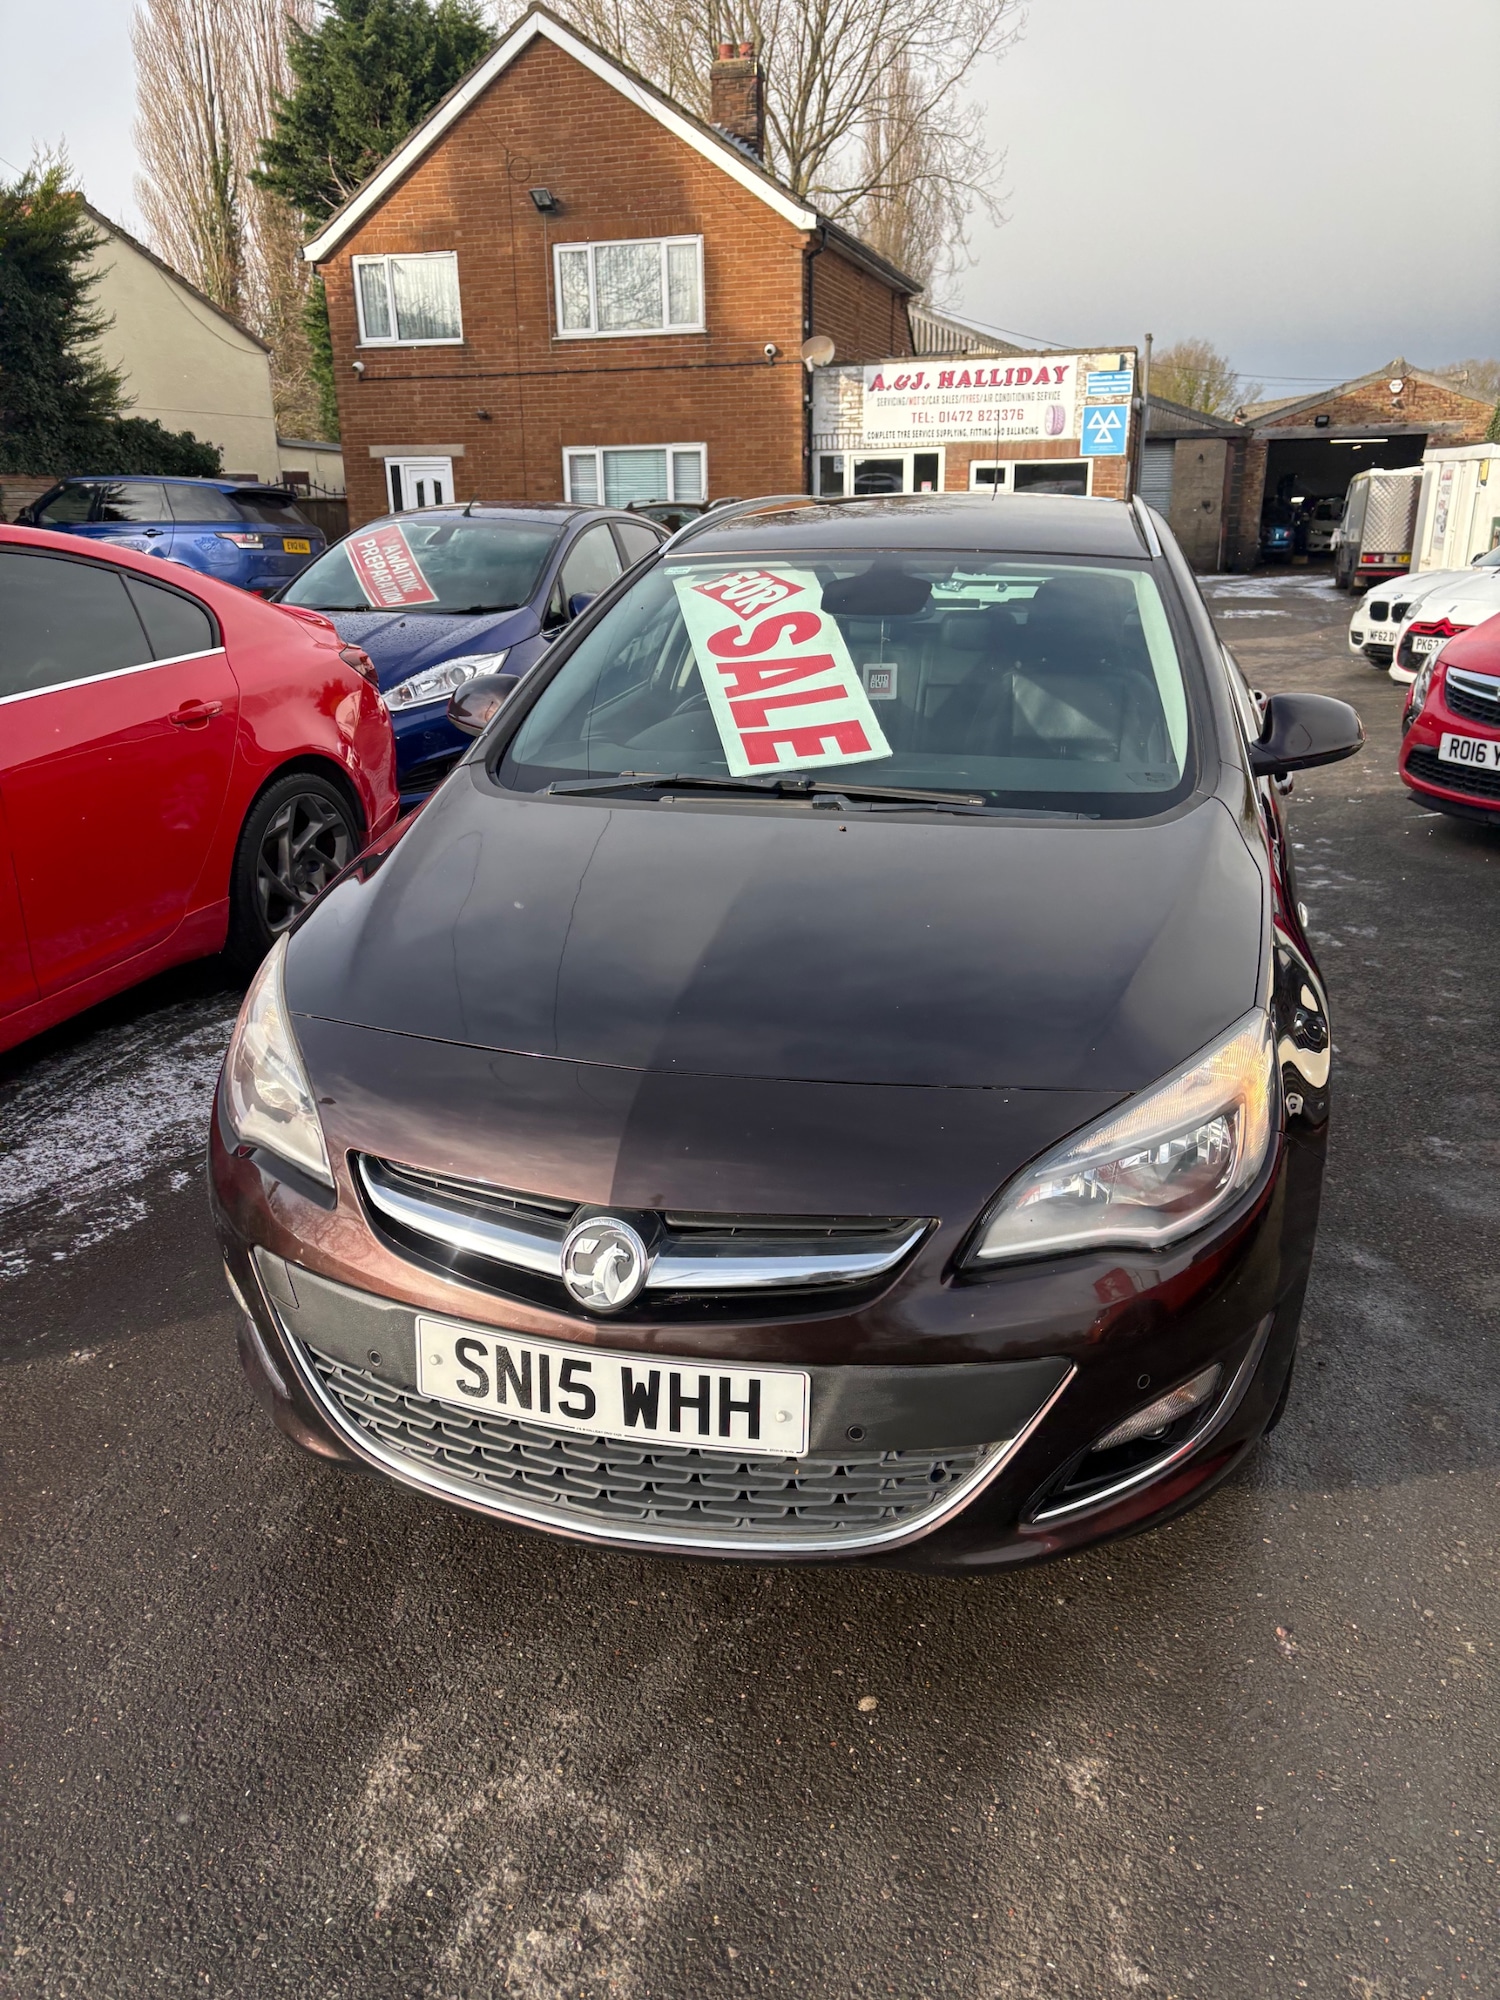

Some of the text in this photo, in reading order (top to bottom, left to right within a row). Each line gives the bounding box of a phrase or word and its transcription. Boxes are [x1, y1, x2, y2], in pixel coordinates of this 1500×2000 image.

[937, 365, 1070, 390] HALLIDAY
[994, 391, 1036, 402] CONDITIONING
[1036, 390, 1061, 401] SERVICE
[911, 408, 1025, 424] TEL: 01472 823376
[867, 429, 896, 440] COMPLETE
[897, 429, 911, 439] TYRE
[912, 428, 935, 439] SERVICE
[969, 427, 992, 437] FITTING
[1006, 426, 1039, 436] BALANCING
[357, 538, 406, 604] PREPARATION
[382, 544, 422, 593] AWAITING
[704, 571, 790, 616] FOR
[706, 610, 873, 766] SALE
[870, 674, 889, 682] AUTO
[1448, 737, 1488, 763] RO16
[454, 1336, 762, 1440] SN15 WHH
